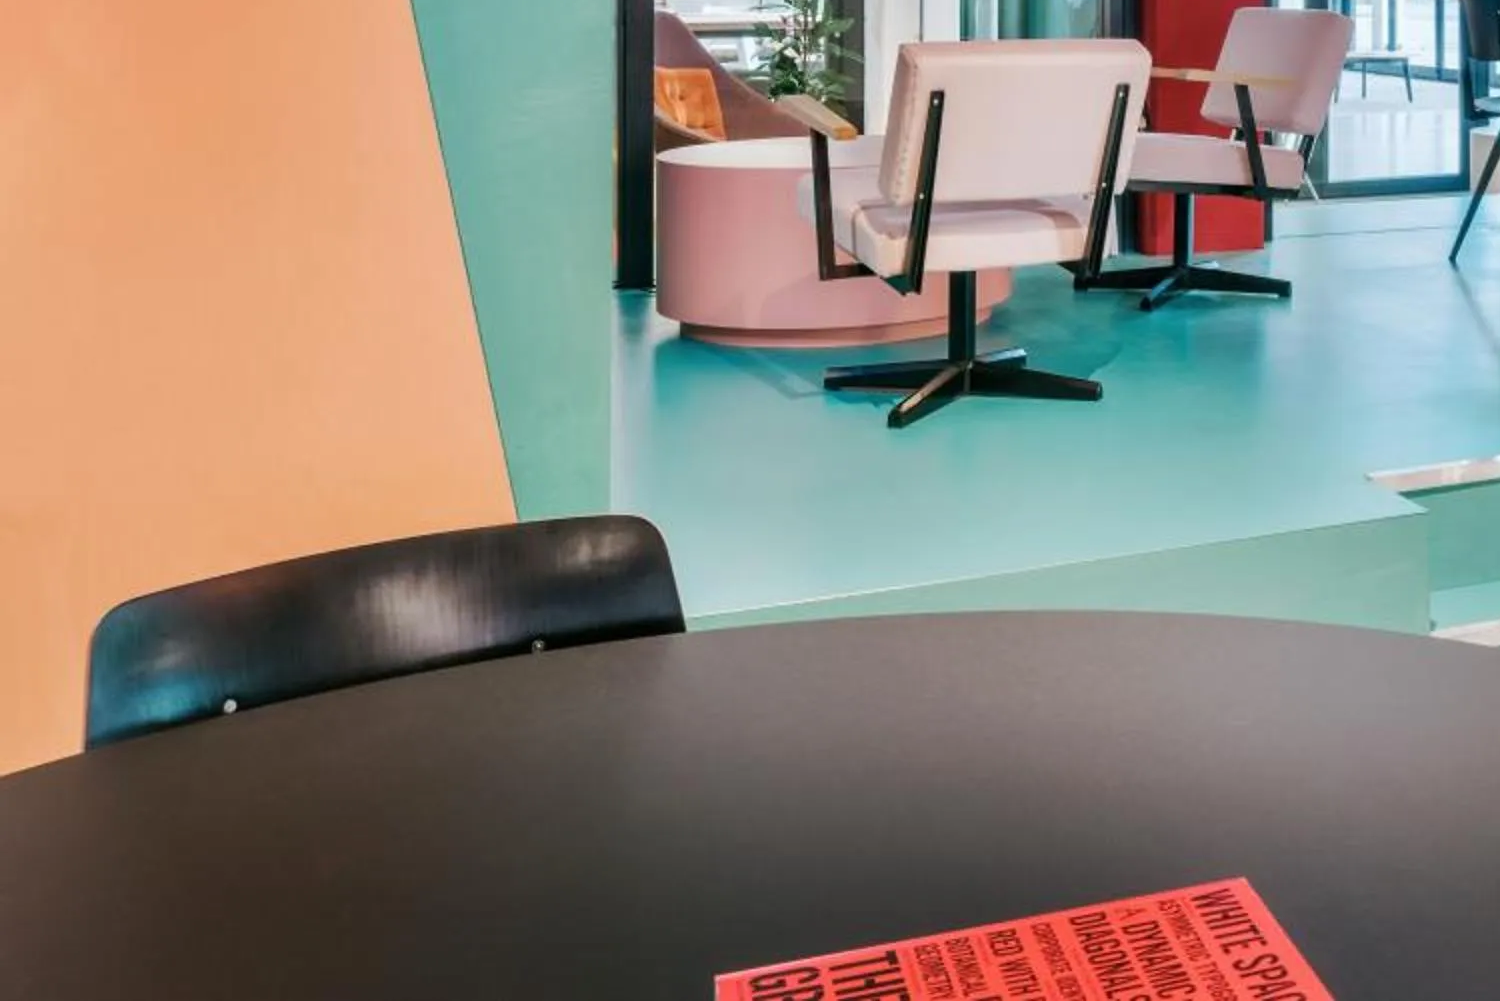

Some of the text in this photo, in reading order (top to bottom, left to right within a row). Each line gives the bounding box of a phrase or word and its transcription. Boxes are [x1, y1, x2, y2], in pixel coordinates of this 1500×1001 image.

[986, 928, 1024, 957] RED
[1030, 922, 1072, 975] CORPORATE
[1191, 888, 1268, 955] WHITE
[914, 943, 957, 999] GEOMETRY
[945, 937, 988, 997] BOTANICAL
[999, 956, 1043, 997] WITH
[1121, 920, 1197, 998] DYNAMIC
